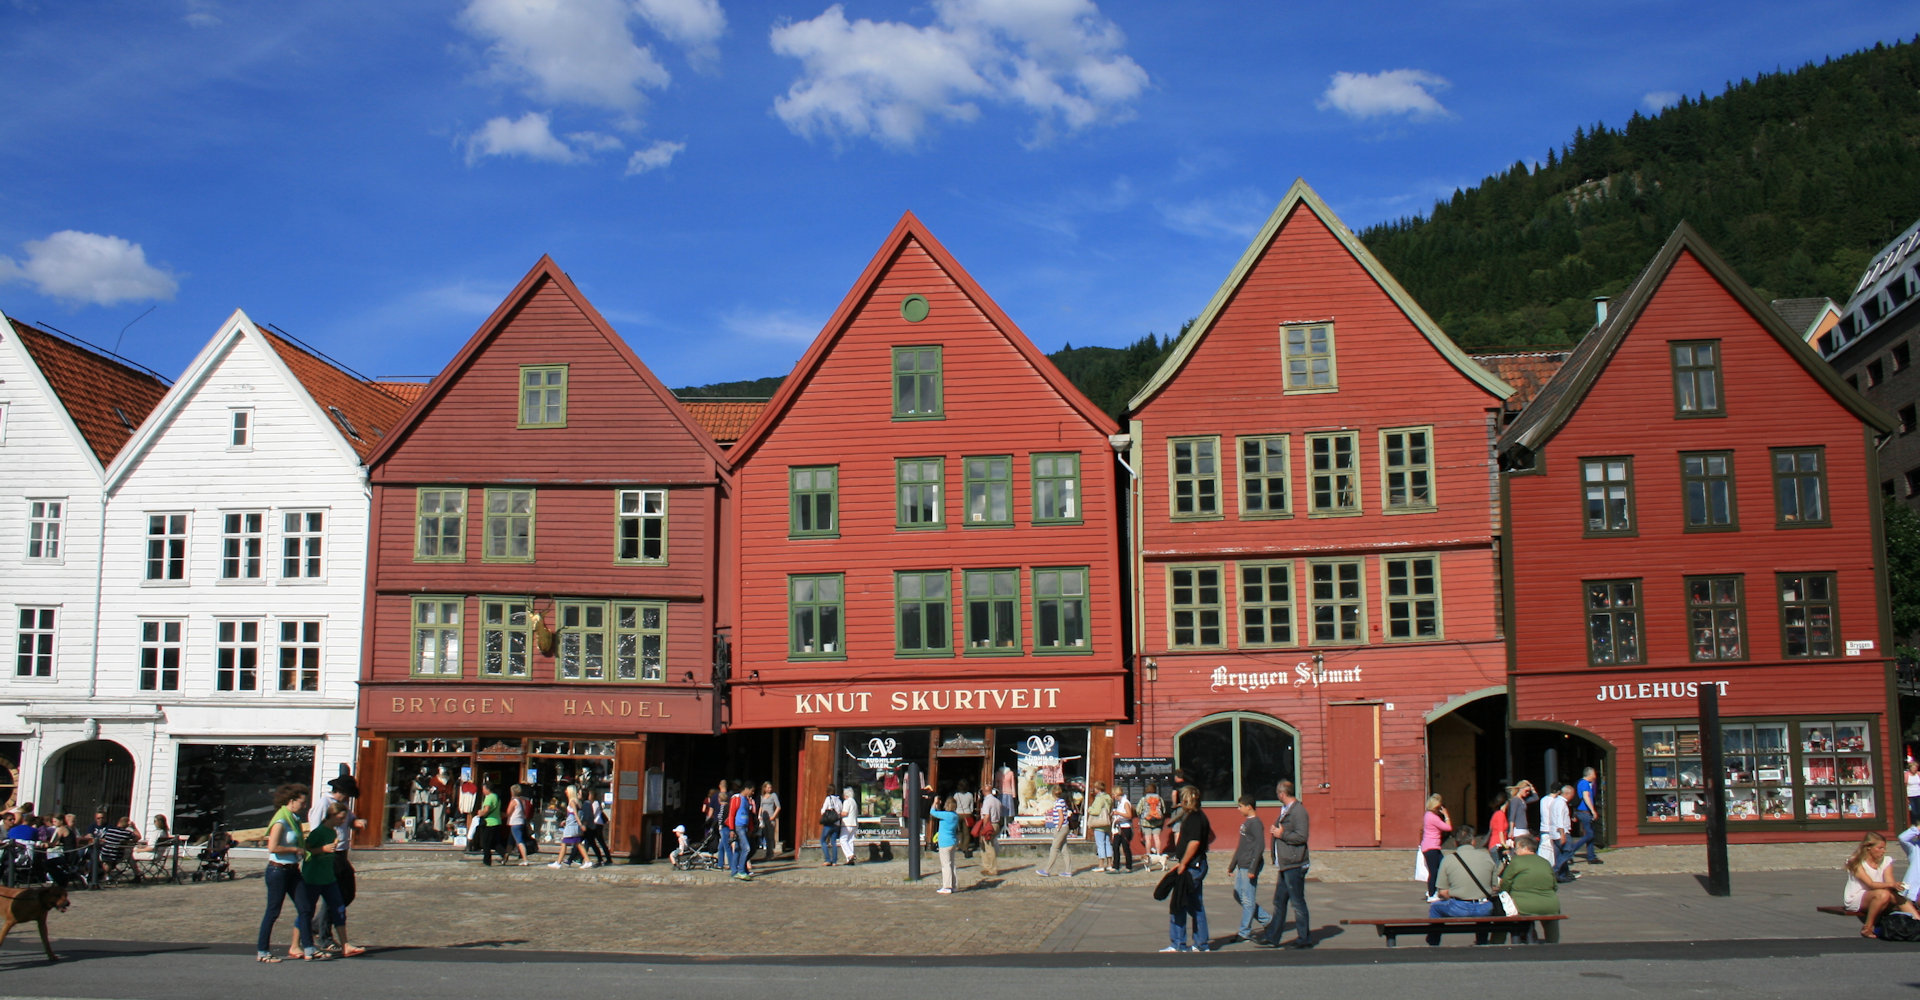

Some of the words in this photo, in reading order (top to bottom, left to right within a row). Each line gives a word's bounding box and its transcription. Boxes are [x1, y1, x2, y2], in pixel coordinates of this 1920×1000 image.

[1849, 641, 1871, 649] Bryggen
[1210, 665, 1288, 693] Bryggen
[795, 692, 872, 714] KNUT
[890, 687, 1061, 712] SKURTVEIT
[1596, 681, 1730, 701] JULEHUST
[391, 697, 515, 714] BRYGGEN
[563, 699, 672, 719] HANDEL
